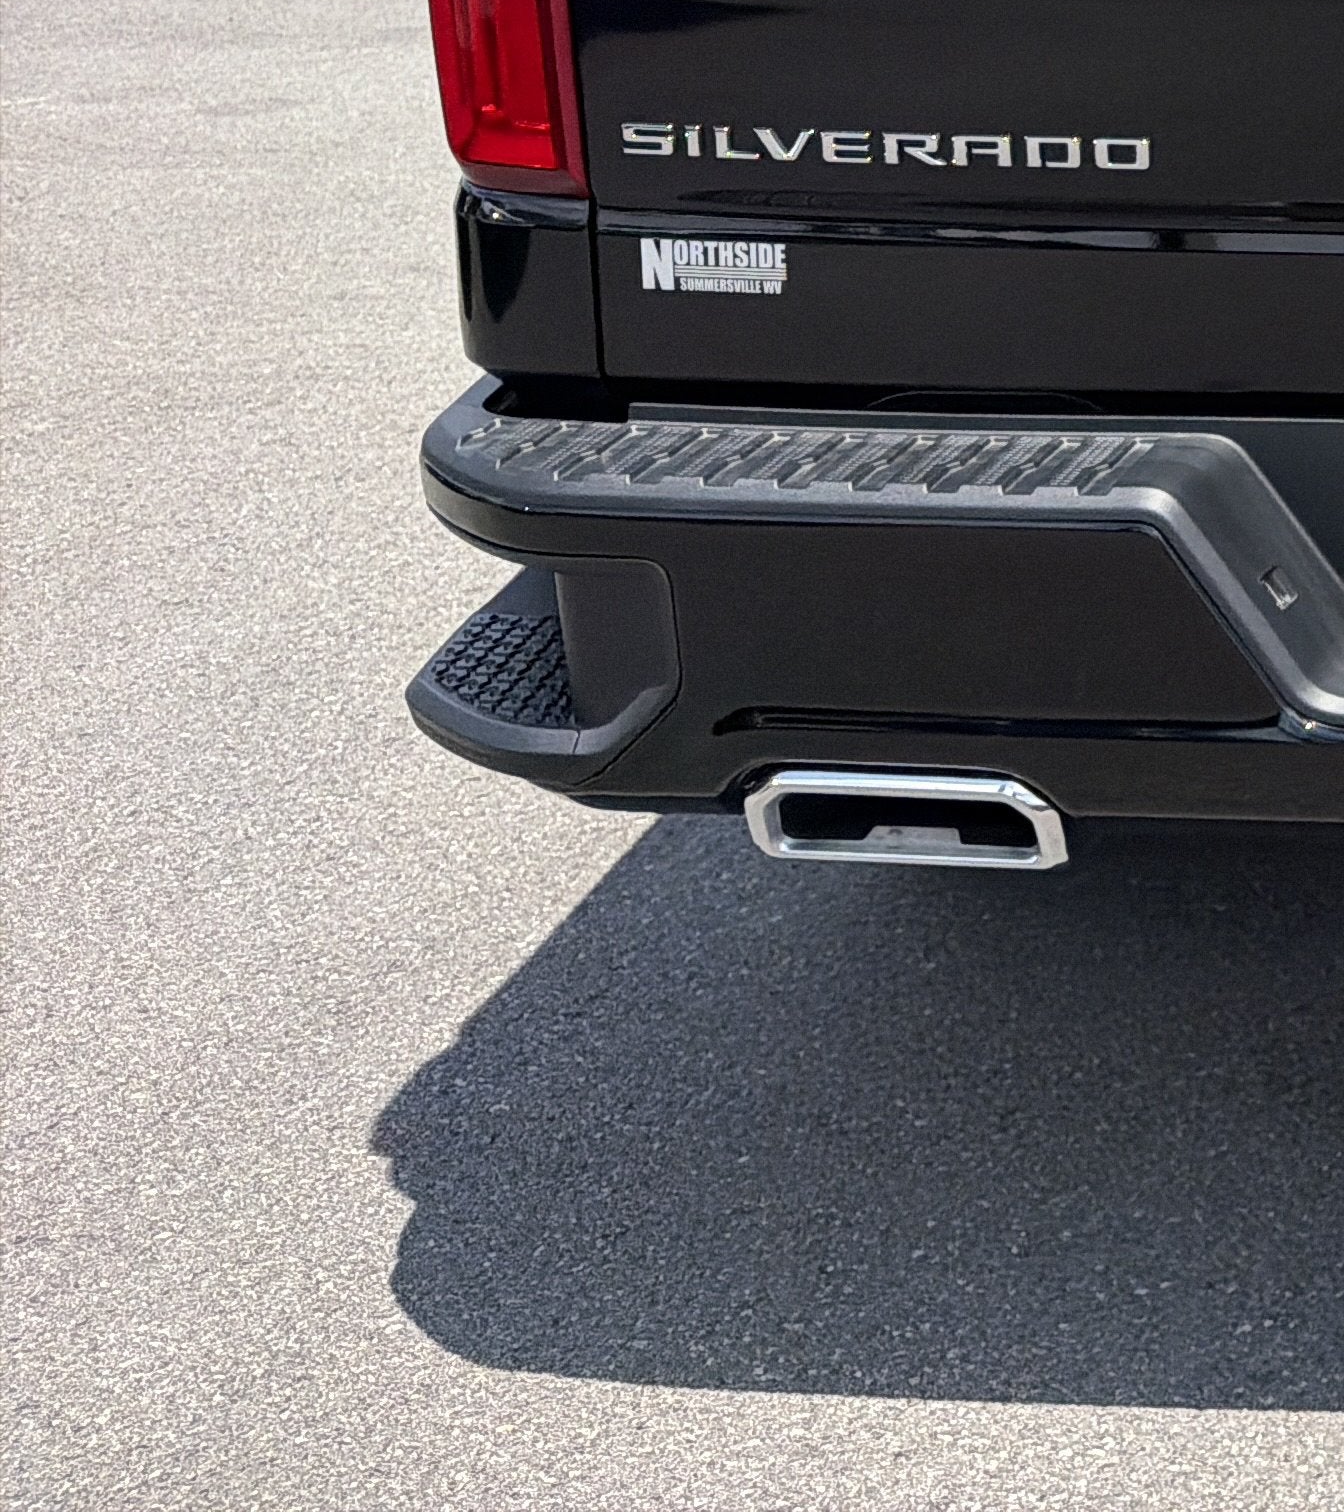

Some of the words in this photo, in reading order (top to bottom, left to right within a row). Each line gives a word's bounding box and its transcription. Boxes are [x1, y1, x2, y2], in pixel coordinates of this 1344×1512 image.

[621, 121, 1150, 170] SILVERADO
[640, 237, 787, 291] NORTHSIDE
[680, 277, 761, 293] SUMMERSVILLE
[763, 280, 782, 294] WV
